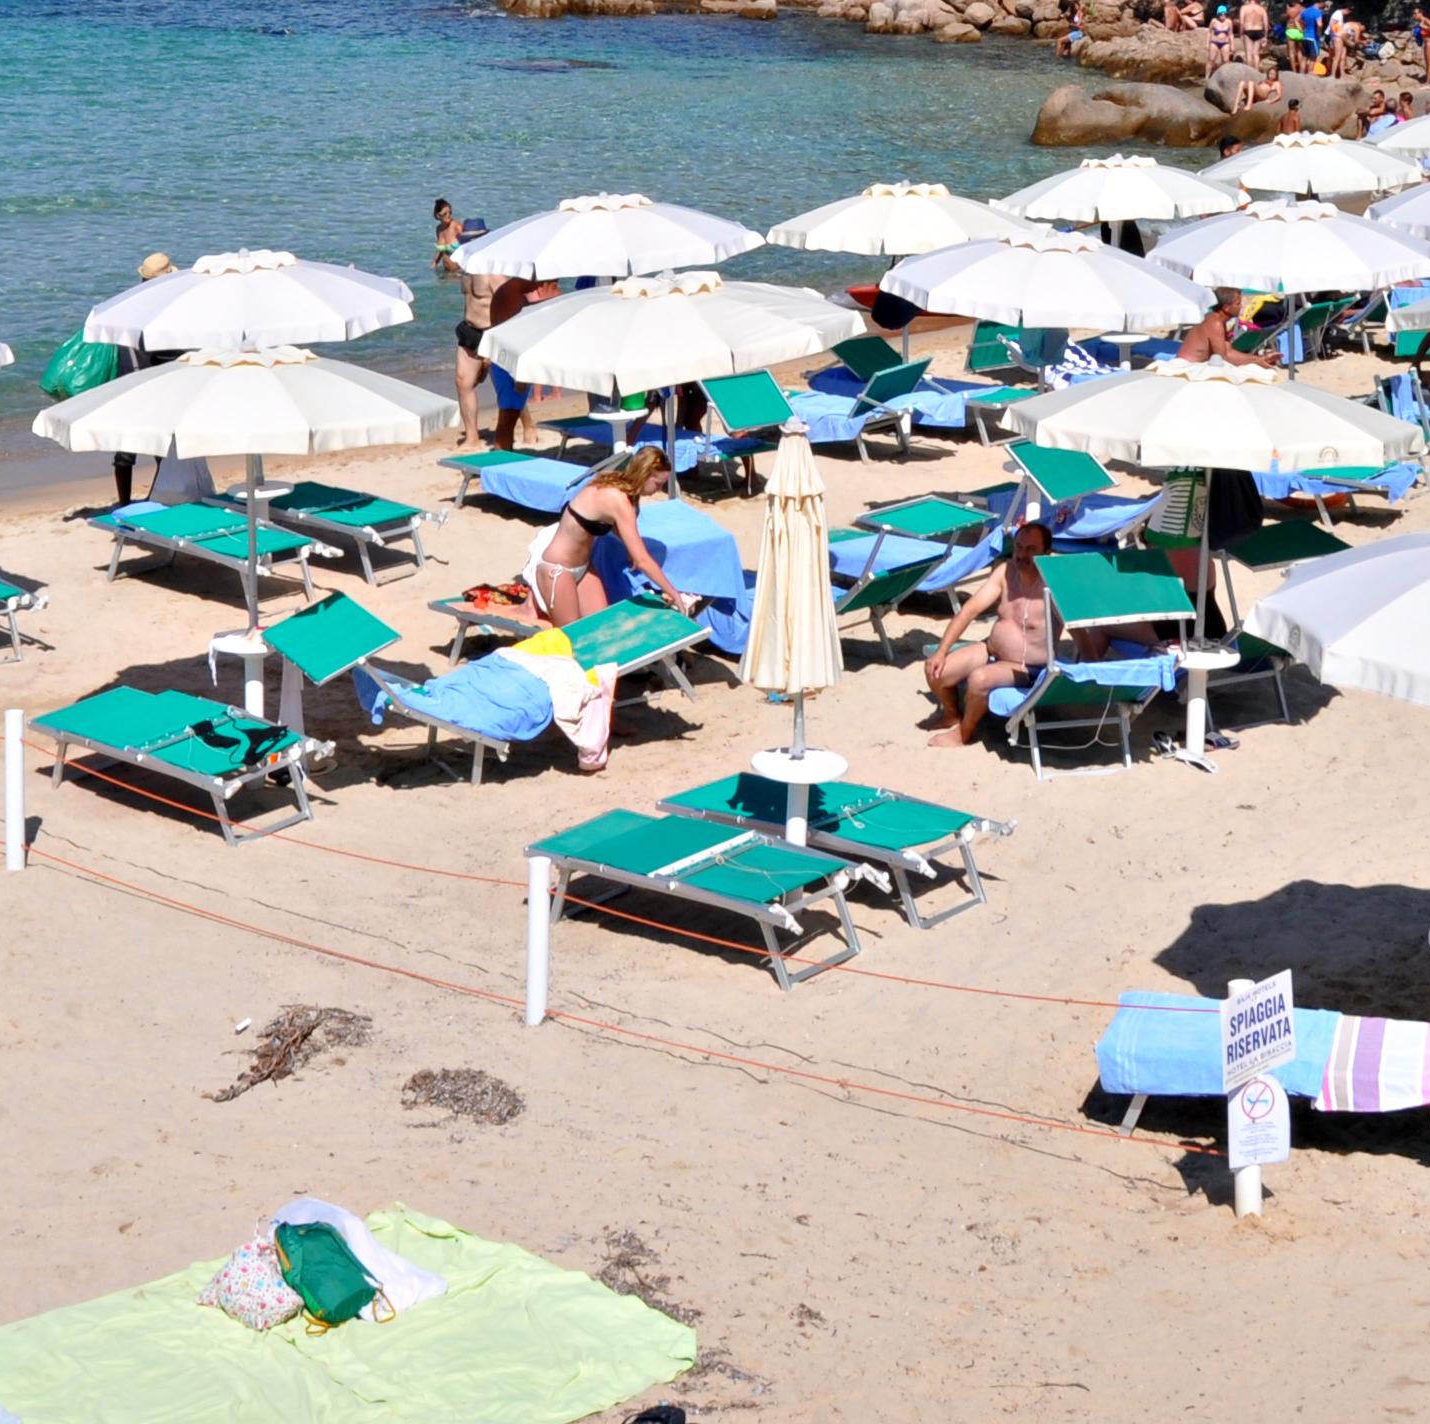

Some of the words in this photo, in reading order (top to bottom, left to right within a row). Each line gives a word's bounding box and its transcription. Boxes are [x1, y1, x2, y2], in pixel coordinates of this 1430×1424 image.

[1229, 992, 1286, 1037] SPIAGGIA
[1226, 1015, 1292, 1065] RISERVATA
[1226, 1061, 1248, 1076] HOTEL
